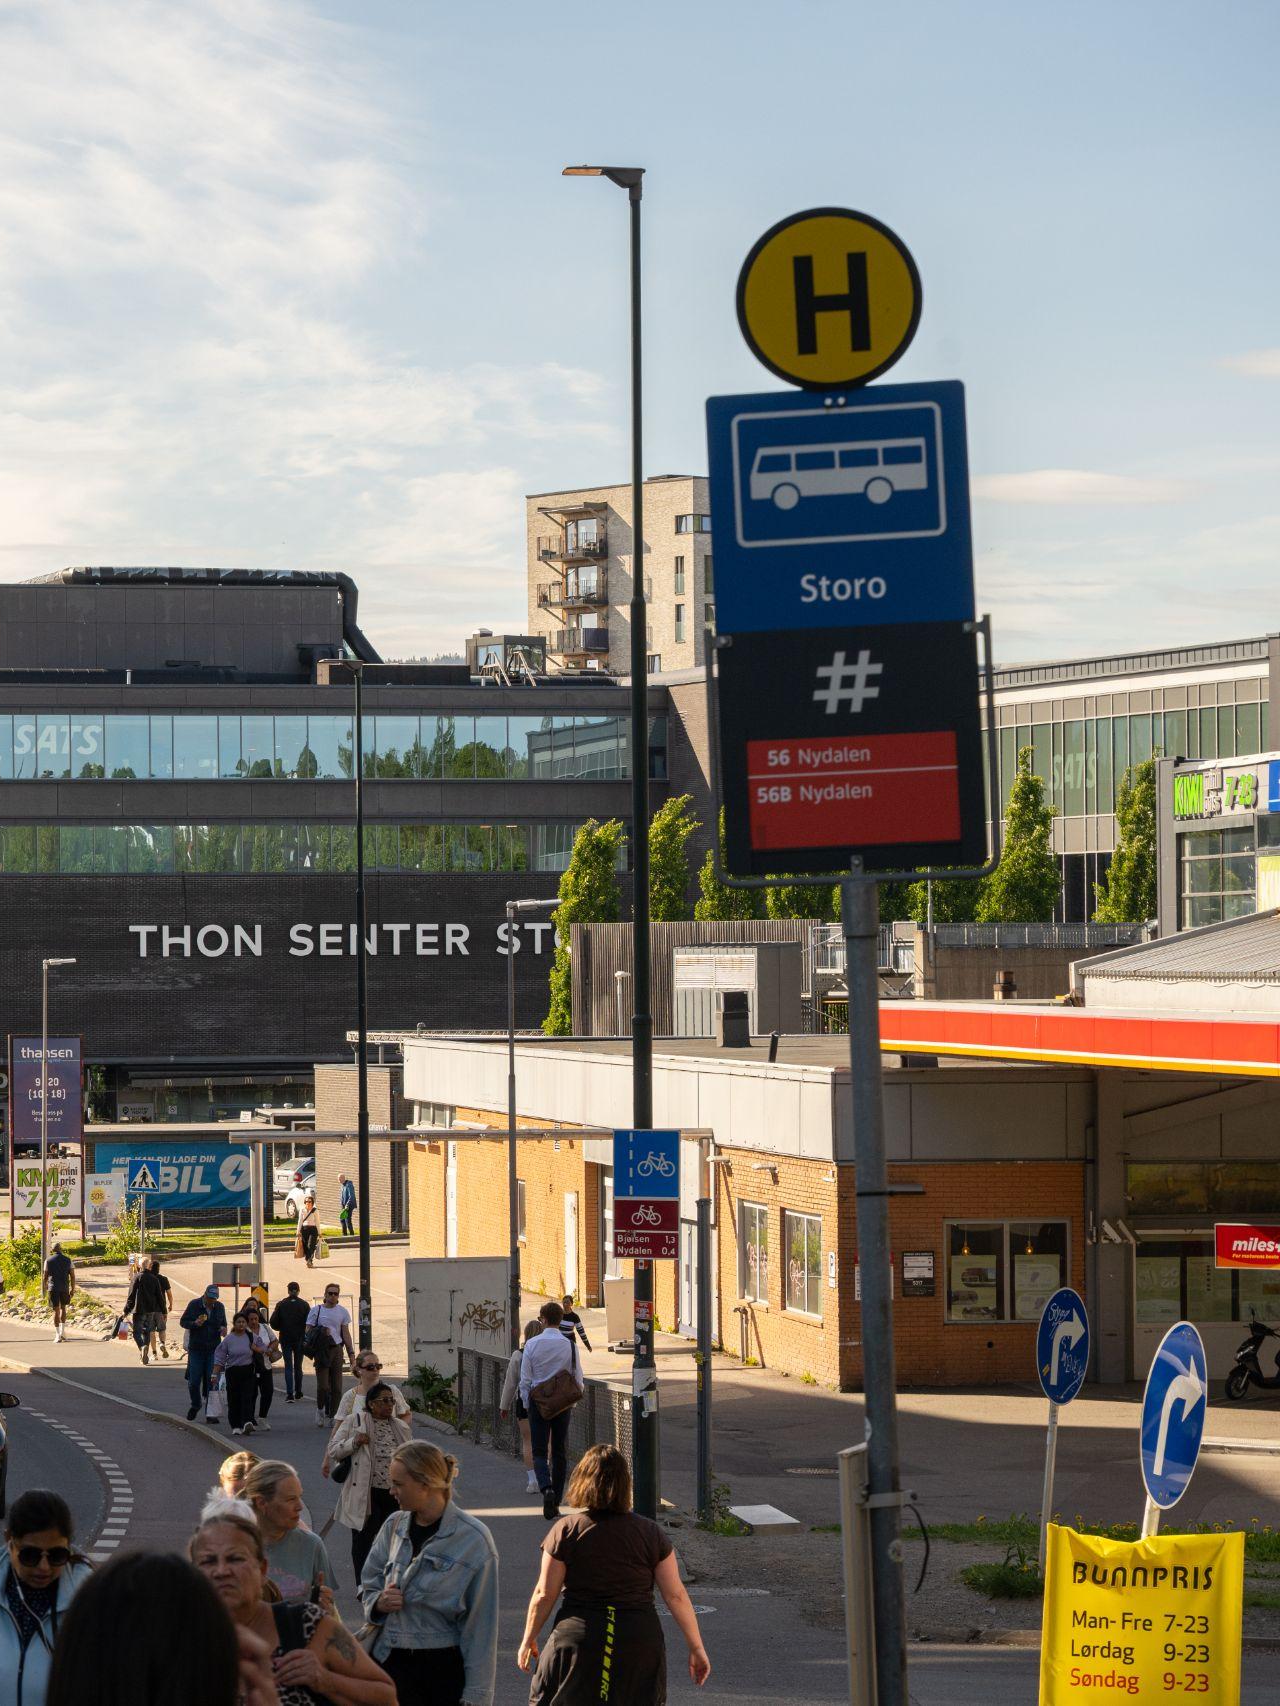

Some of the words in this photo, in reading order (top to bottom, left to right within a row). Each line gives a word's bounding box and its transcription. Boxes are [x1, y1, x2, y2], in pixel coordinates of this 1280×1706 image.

[793, 252, 871, 355] H
[800, 574, 887, 603] Storo
[11, 724, 102, 755] SATS
[767, 749, 790, 766] 56
[798, 747, 871, 767] Nydalen
[1048, 752, 1100, 791] SATS
[756, 786, 792, 803] 56B
[799, 783, 873, 804] Nydalen
[1174, 773, 1203, 817] KIWI
[129, 924, 262, 957] THON
[289, 923, 470, 956] SENTER
[17, 1167, 59, 1187] KIWI
[61, 1177, 76, 1188] pris
[26, 1189, 70, 1208] 723
[617, 1246, 652, 1256] Nydalen
[661, 1247, 676, 1256] 0,4
[665, 1235, 676, 1244] 1,3
[1163, 1614, 1210, 1634] 7-23
[1071, 1639, 1135, 1665] Lørdag
[1163, 1643, 1210, 1664] 9-23
[1070, 1668, 1140, 1695] Søndag
[1163, 1672, 1210, 1692] 9-23
